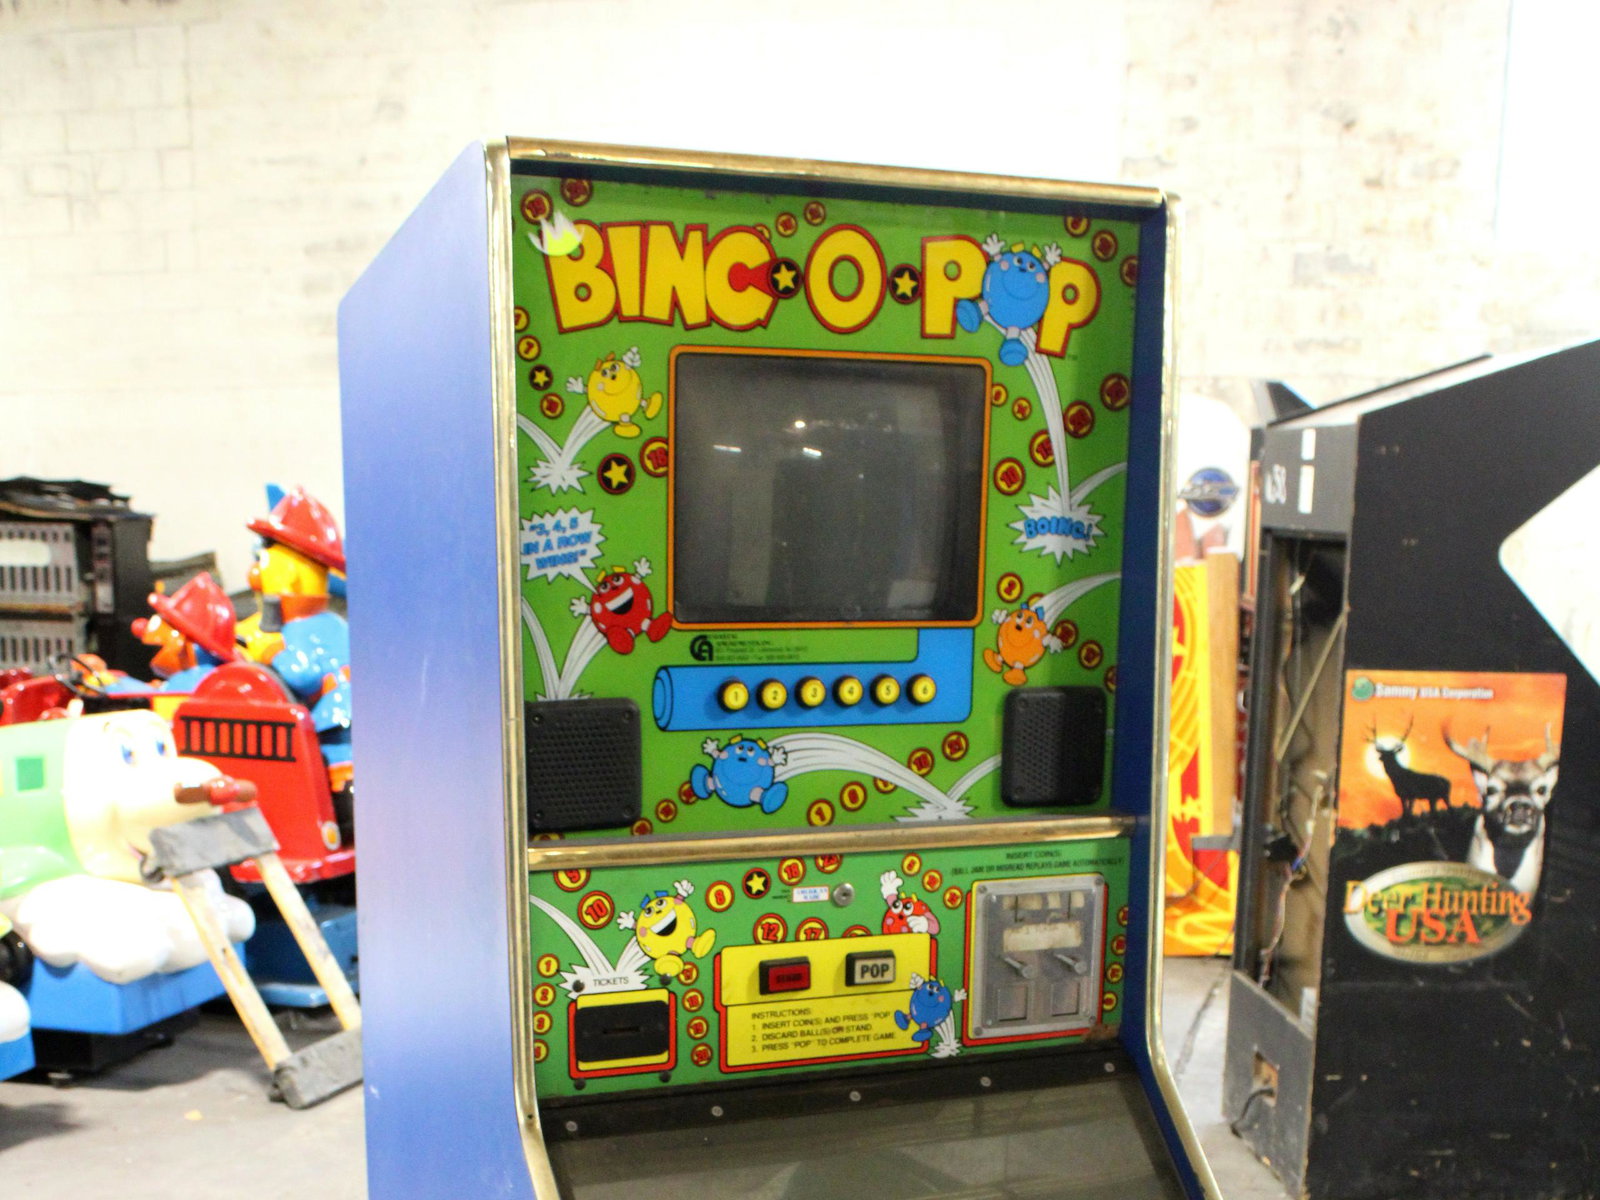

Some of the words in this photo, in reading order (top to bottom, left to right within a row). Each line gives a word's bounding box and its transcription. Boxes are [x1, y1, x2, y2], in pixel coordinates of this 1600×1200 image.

[543, 538, 554, 552] A
[584, 898, 607, 923] 10
[1343, 880, 1414, 914] Deer
[1418, 881, 1533, 926] Hunting
[761, 922, 780, 942] 12
[1385, 907, 1483, 944] USA
[860, 963, 890, 979] POP
[593, 976, 629, 987] TICKETS
[762, 1020, 790, 1030] INSERT
[824, 1015, 841, 1024] AND
[842, 1013, 869, 1022] PRESS
[762, 1031, 798, 1041] DISCARD
[762, 1042, 789, 1052] PRESS
[817, 1038, 828, 1046] TO
[829, 1034, 871, 1045] COMPLETE
